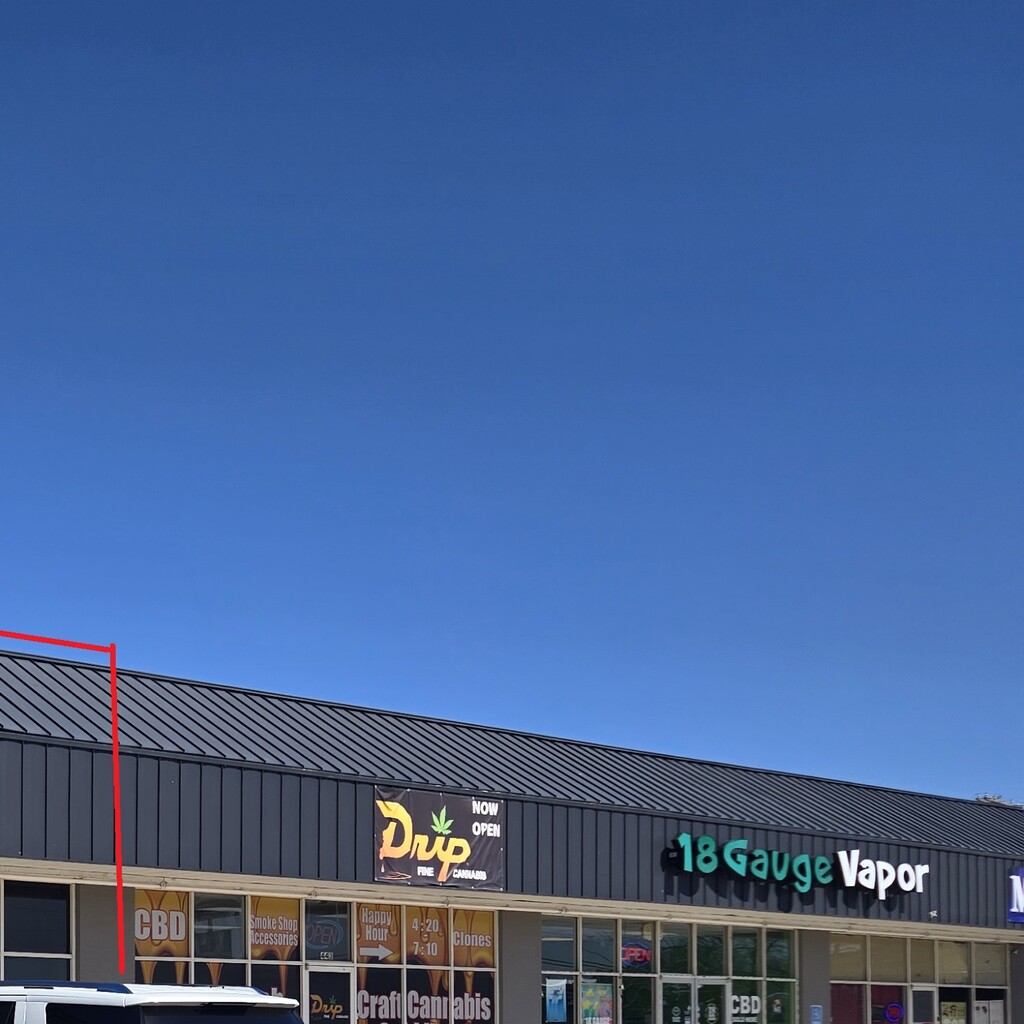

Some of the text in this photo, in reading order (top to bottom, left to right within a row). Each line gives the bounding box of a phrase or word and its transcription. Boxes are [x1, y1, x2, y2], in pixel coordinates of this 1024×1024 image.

[472, 801, 499, 816] NOW
[472, 821, 501, 837] OPEN
[376, 800, 471, 881] Drip
[417, 866, 487, 880] FINE CANNABIS
[677, 832, 930, 900] 18 Gauge Vapor
[135, 908, 186, 941] CBD
[250, 915, 298, 932] Smoke Shop
[362, 907, 392, 925] Happy
[250, 931, 298, 946] Accessories
[307, 924, 337, 945] OPEN
[365, 927, 388, 941] Hour
[453, 931, 492, 947] Clones
[310, 994, 343, 1019] Drip
[357, 990, 401, 1019] Craft
[730, 995, 761, 1014] CBD
